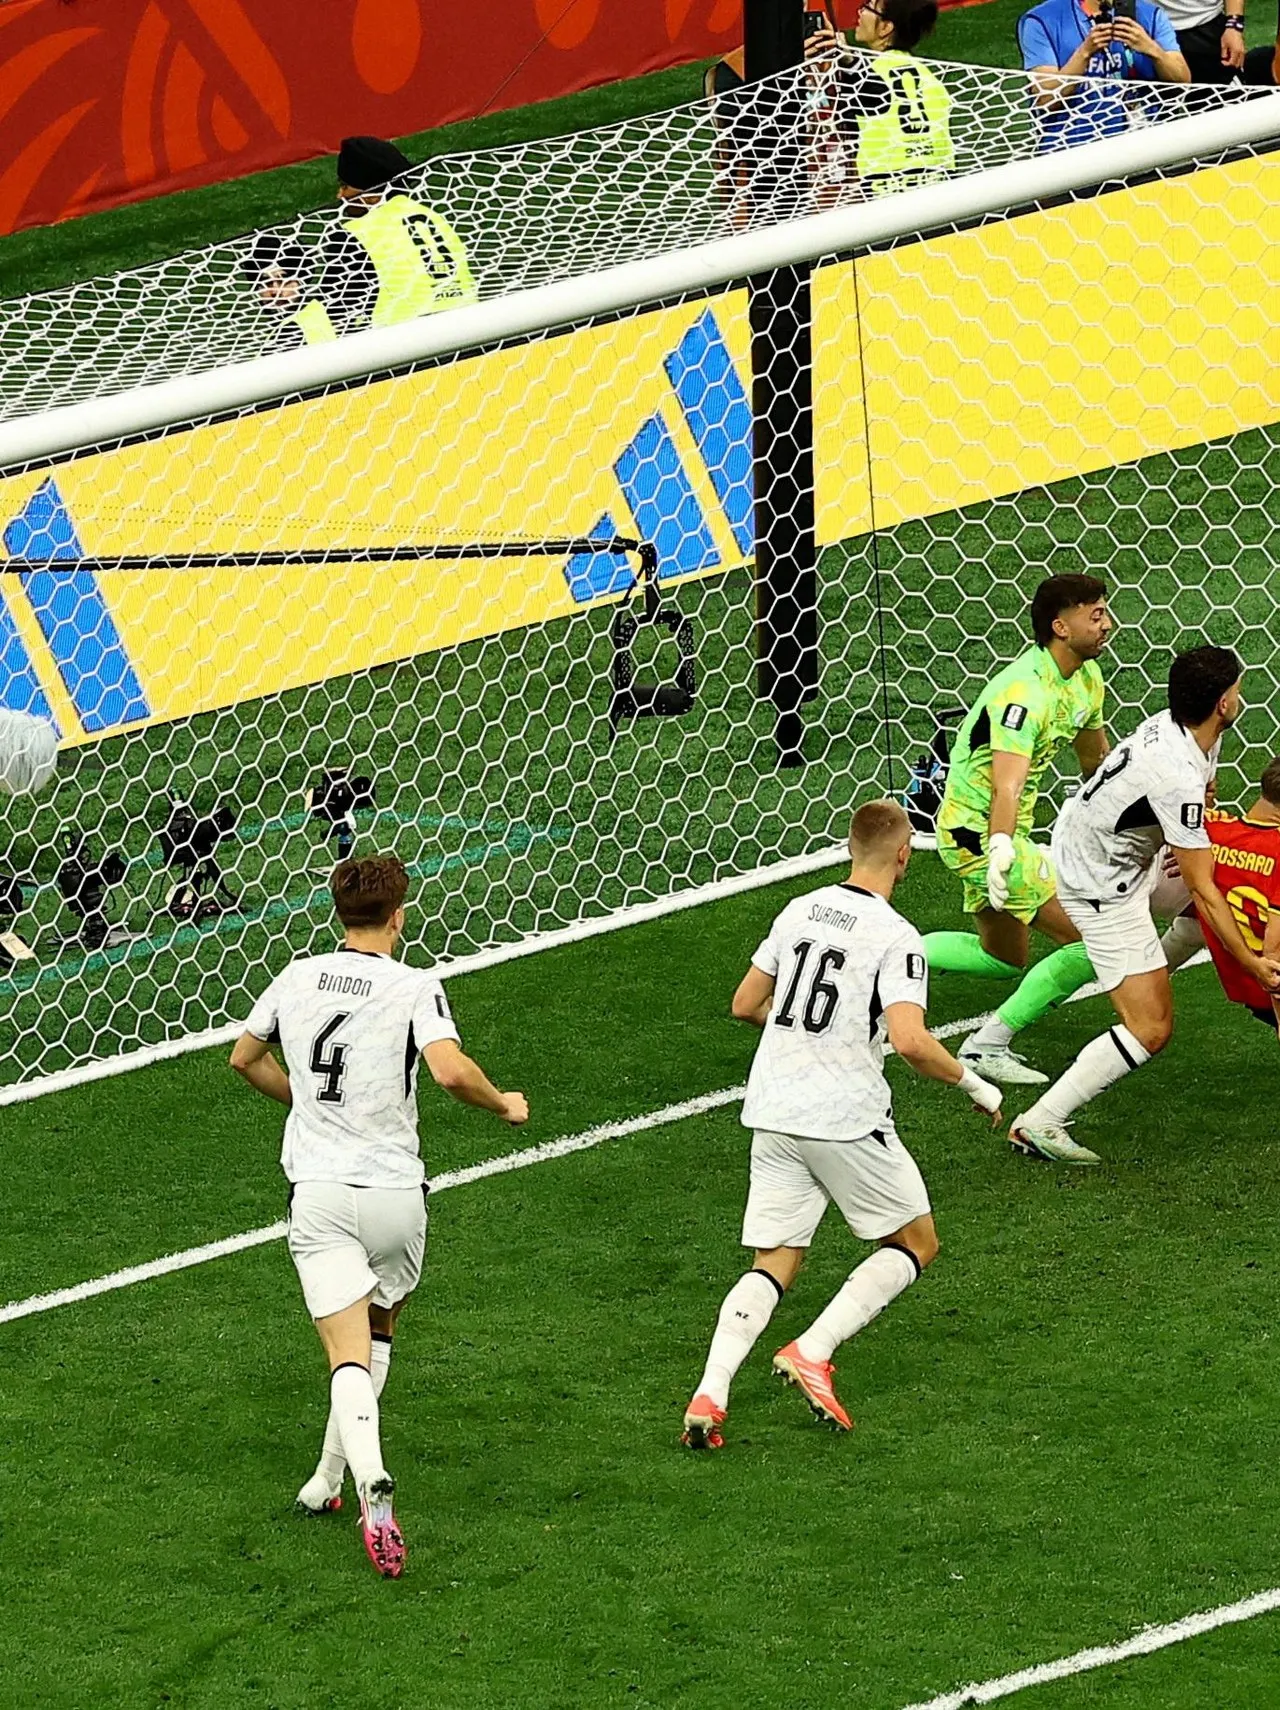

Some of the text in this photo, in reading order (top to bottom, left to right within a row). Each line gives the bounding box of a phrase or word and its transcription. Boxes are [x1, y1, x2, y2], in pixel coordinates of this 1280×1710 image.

[1211, 843, 1275, 876] ROSSARD
[808, 904, 858, 932] SURMAN
[318, 973, 372, 997] BINDON
[773, 937, 849, 1038] 16
[309, 1010, 353, 1107] 4
